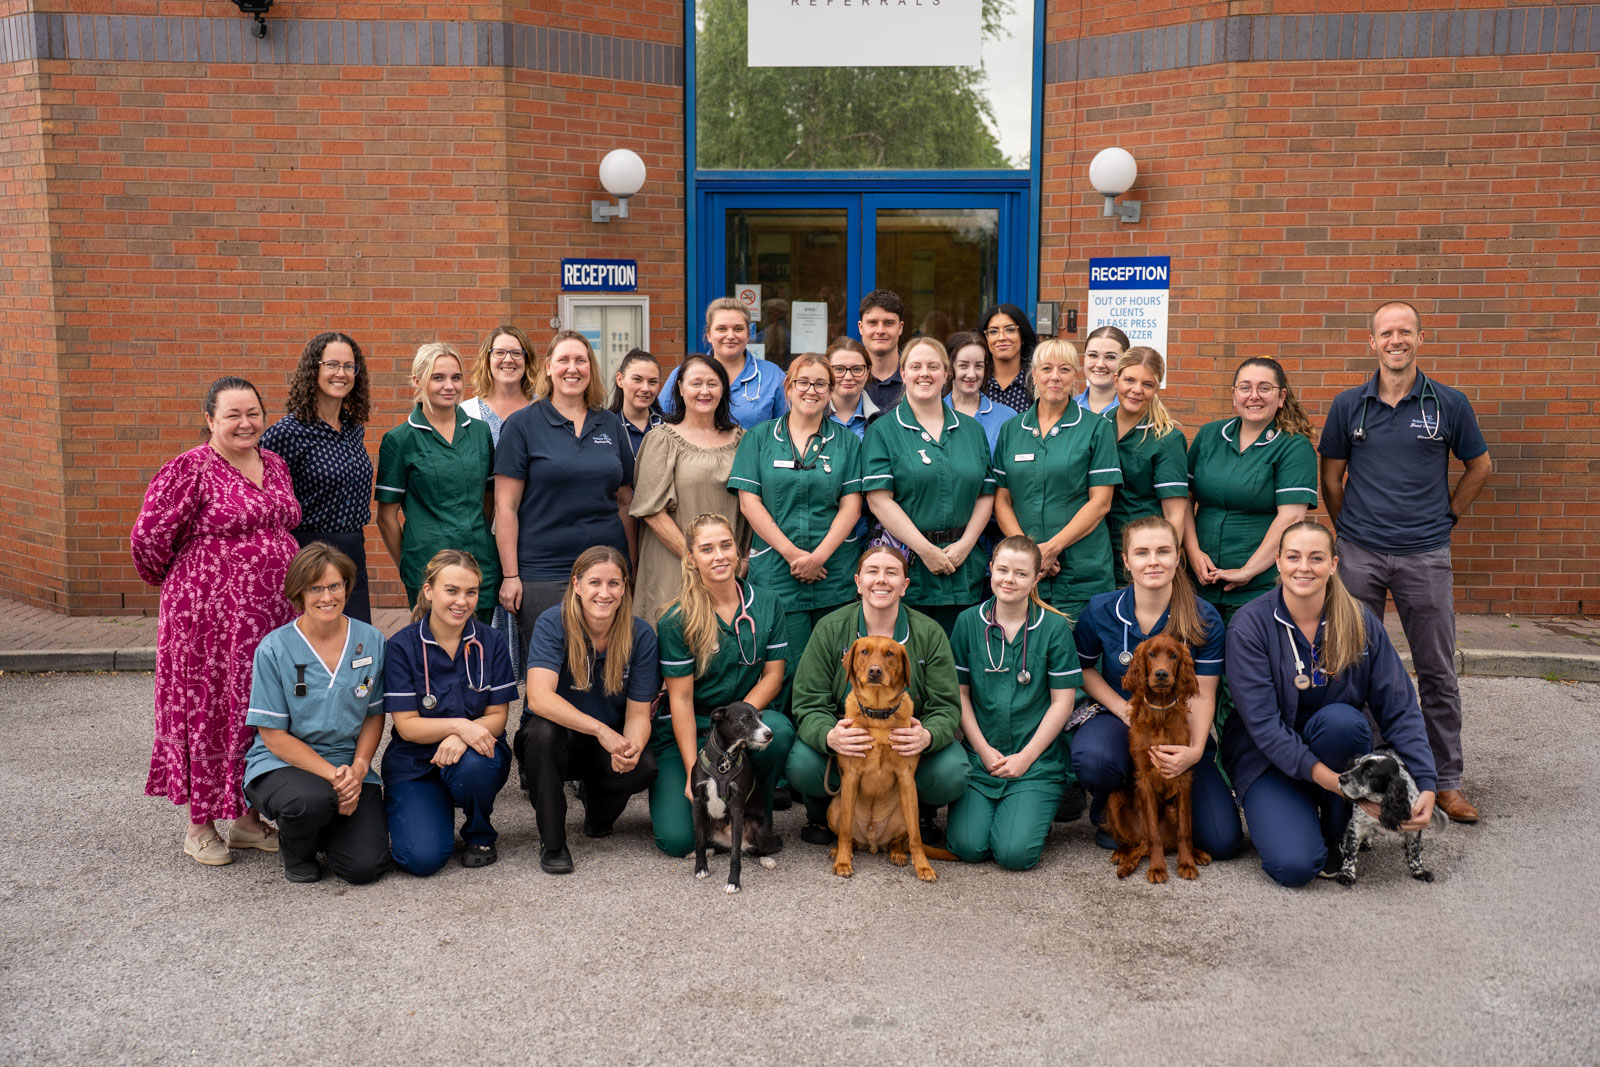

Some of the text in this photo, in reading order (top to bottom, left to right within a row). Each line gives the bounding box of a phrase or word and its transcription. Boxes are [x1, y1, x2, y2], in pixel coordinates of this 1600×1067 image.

[564, 264, 635, 286] RECEPTION
[1091, 266, 1167, 281] RECEPTION
[1095, 296, 1161, 306] OUT OF HOURS
[1110, 308, 1144, 316] CLIENTS
[1097, 319, 1157, 328] PLEASE PRESS
[1123, 330, 1153, 339] UZZER
